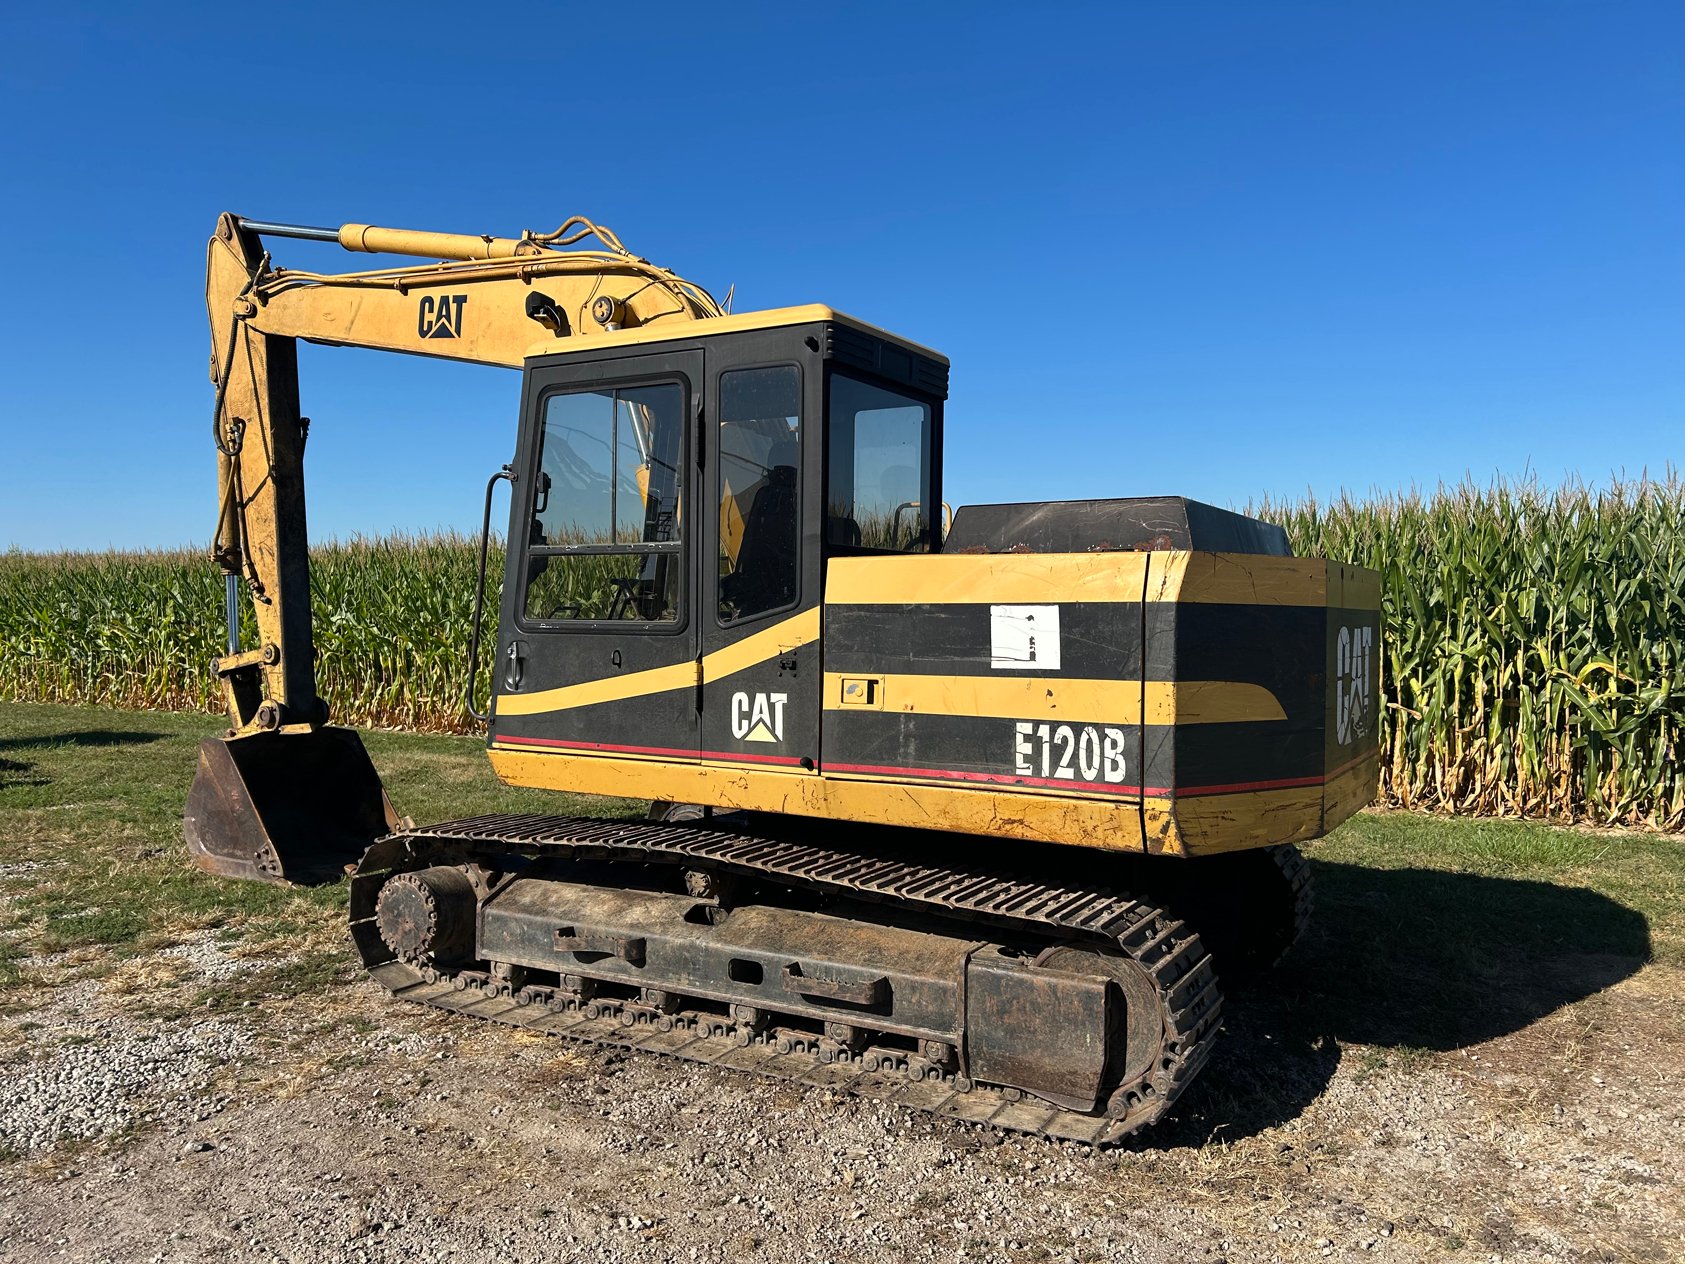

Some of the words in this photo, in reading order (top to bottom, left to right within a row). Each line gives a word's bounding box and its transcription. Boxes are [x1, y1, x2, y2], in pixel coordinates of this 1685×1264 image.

[418, 294, 468, 339] CAT
[1336, 626, 1372, 745] CAT
[731, 691, 788, 743] CAT
[1015, 722, 1126, 783] E120B
